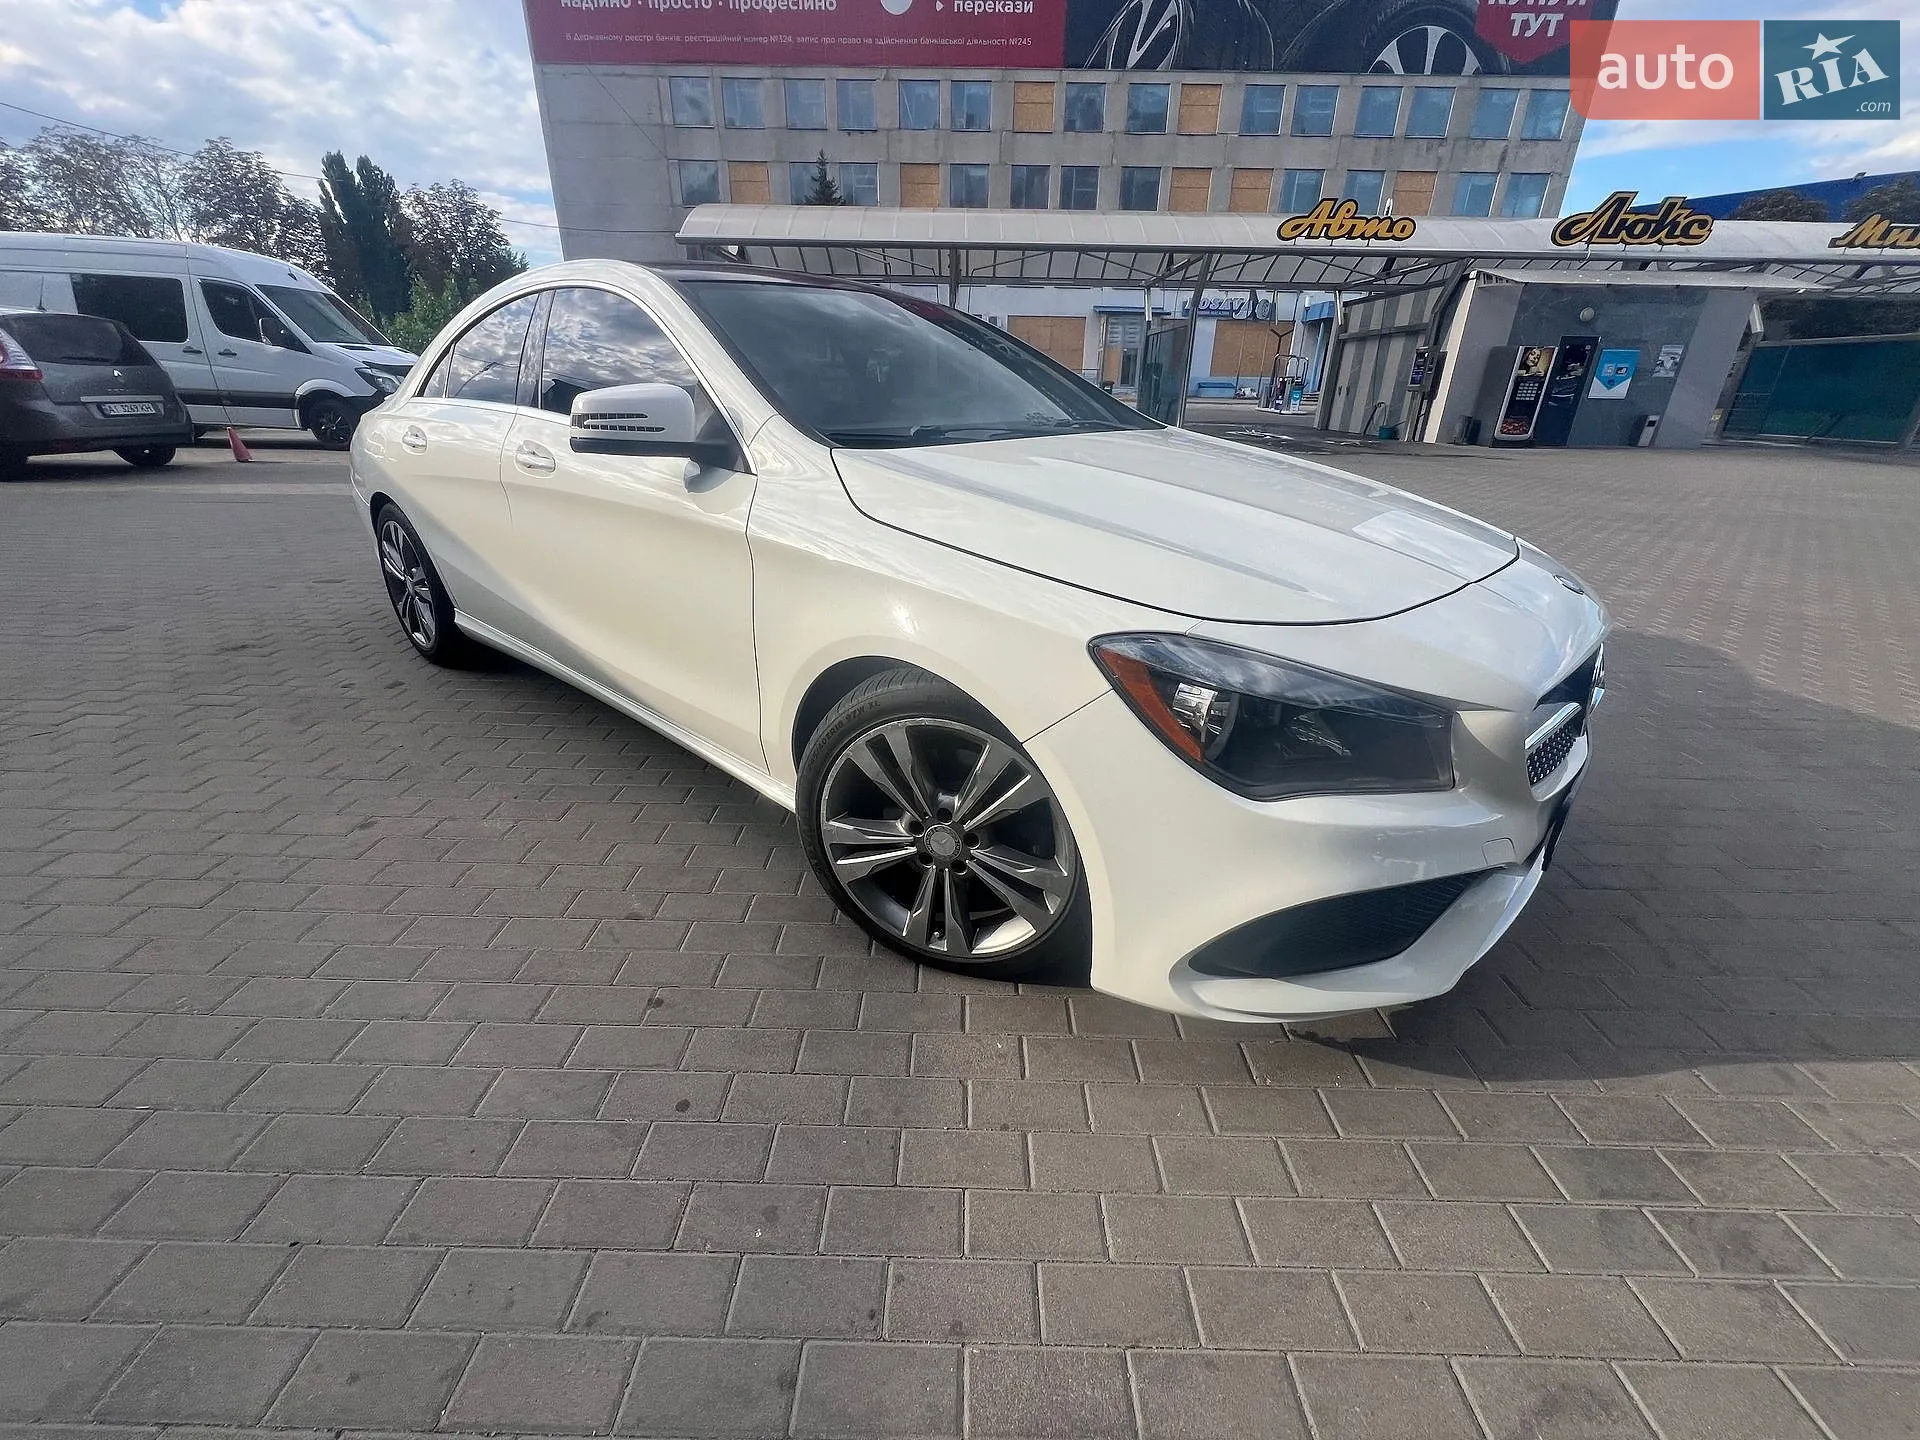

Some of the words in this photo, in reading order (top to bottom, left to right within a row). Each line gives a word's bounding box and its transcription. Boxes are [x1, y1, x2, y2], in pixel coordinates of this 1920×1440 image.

[953, 0, 1034, 15] перекази
[1510, 12, 1565, 38] ТУТ
[919, 36, 965, 45] банківської
[966, 37, 1008, 46] діяльності
[1008, 37, 1033, 46] №245
[1277, 197, 1417, 242] Авто
[1551, 190, 1715, 246] Люкс
[1828, 211, 1920, 249] Ми
